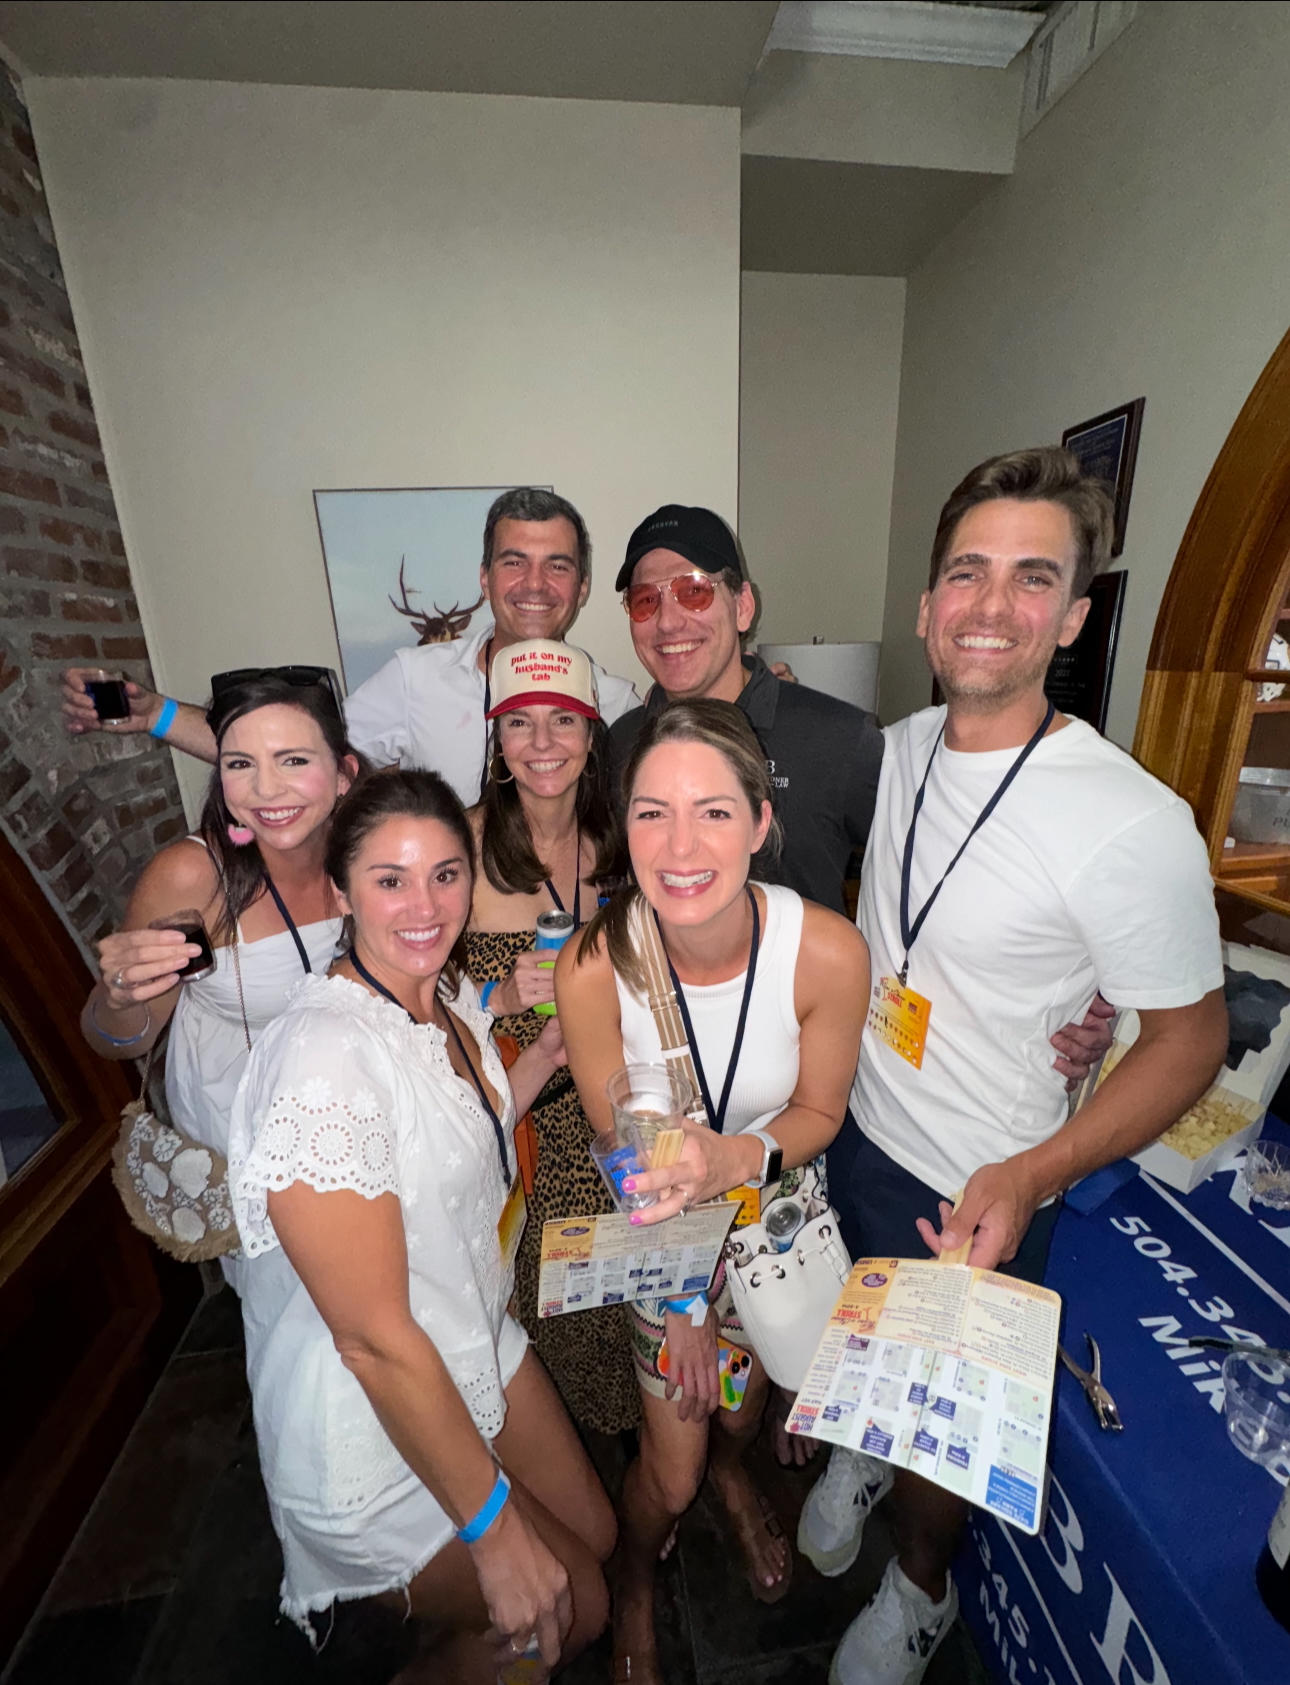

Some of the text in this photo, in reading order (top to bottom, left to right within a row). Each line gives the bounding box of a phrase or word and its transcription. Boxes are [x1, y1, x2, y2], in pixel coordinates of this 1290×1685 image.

[511, 652, 572, 667] put it on my
[515, 662, 568, 674] husband's
[532, 673, 550, 681] tab
[837, 1309, 862, 1319] STROLL
[797, 1405, 820, 1415] STROLL
[791, 1413, 816, 1423] AUGUST
